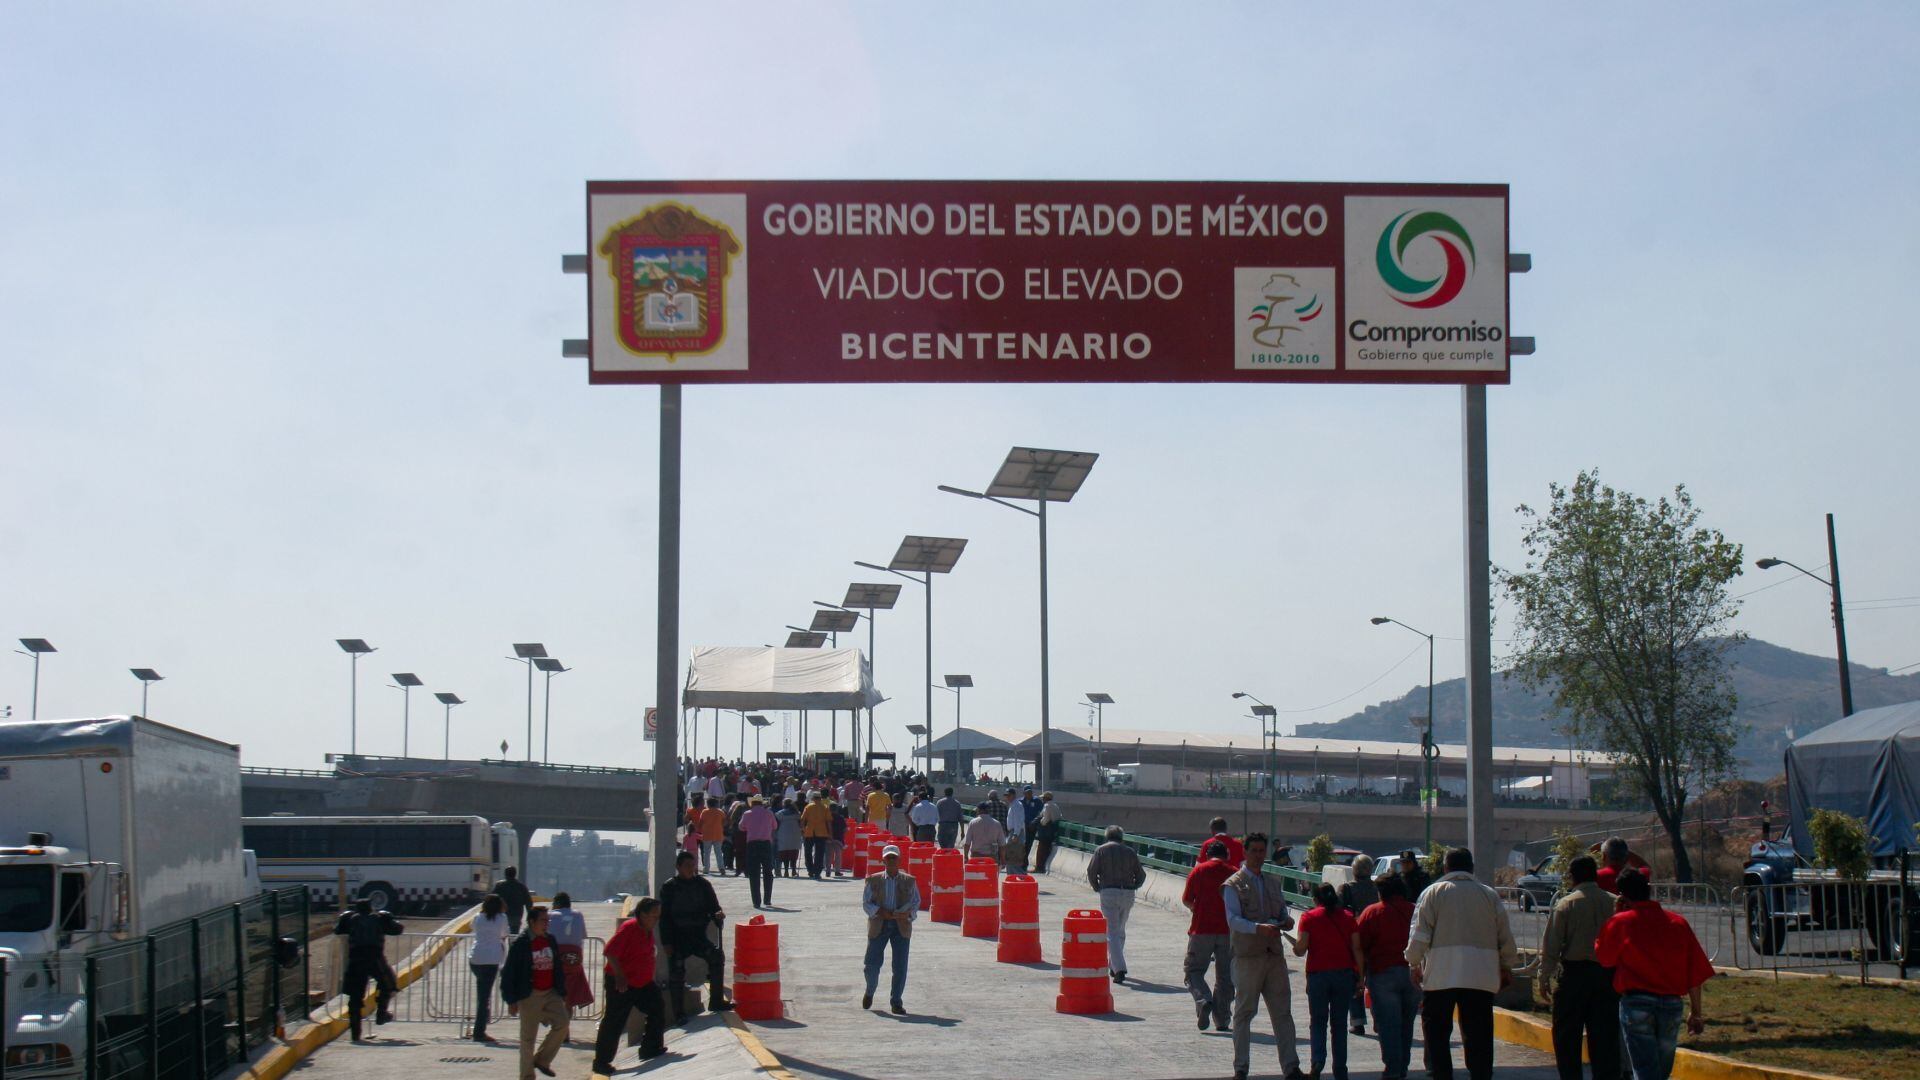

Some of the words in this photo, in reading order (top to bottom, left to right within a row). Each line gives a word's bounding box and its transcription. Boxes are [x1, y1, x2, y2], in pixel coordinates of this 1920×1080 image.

[762, 202, 935, 236] GOBIERNO
[945, 203, 1006, 236] DEL
[1015, 203, 1141, 236] ESTADO
[1151, 204, 1192, 236] DE
[1202, 195, 1328, 237] MÉXICO
[812, 267, 1005, 300] VIADUCTO
[1024, 267, 1183, 300] ELEVADO
[841, 332, 1152, 360] BICENTENARIO
[1348, 319, 1503, 348] Compromiso
[1251, 353, 1320, 364] 1810-2010
[1357, 347, 1418, 361] Gobierno
[1422, 351, 1445, 363] que
[1449, 348, 1494, 363] cumple
